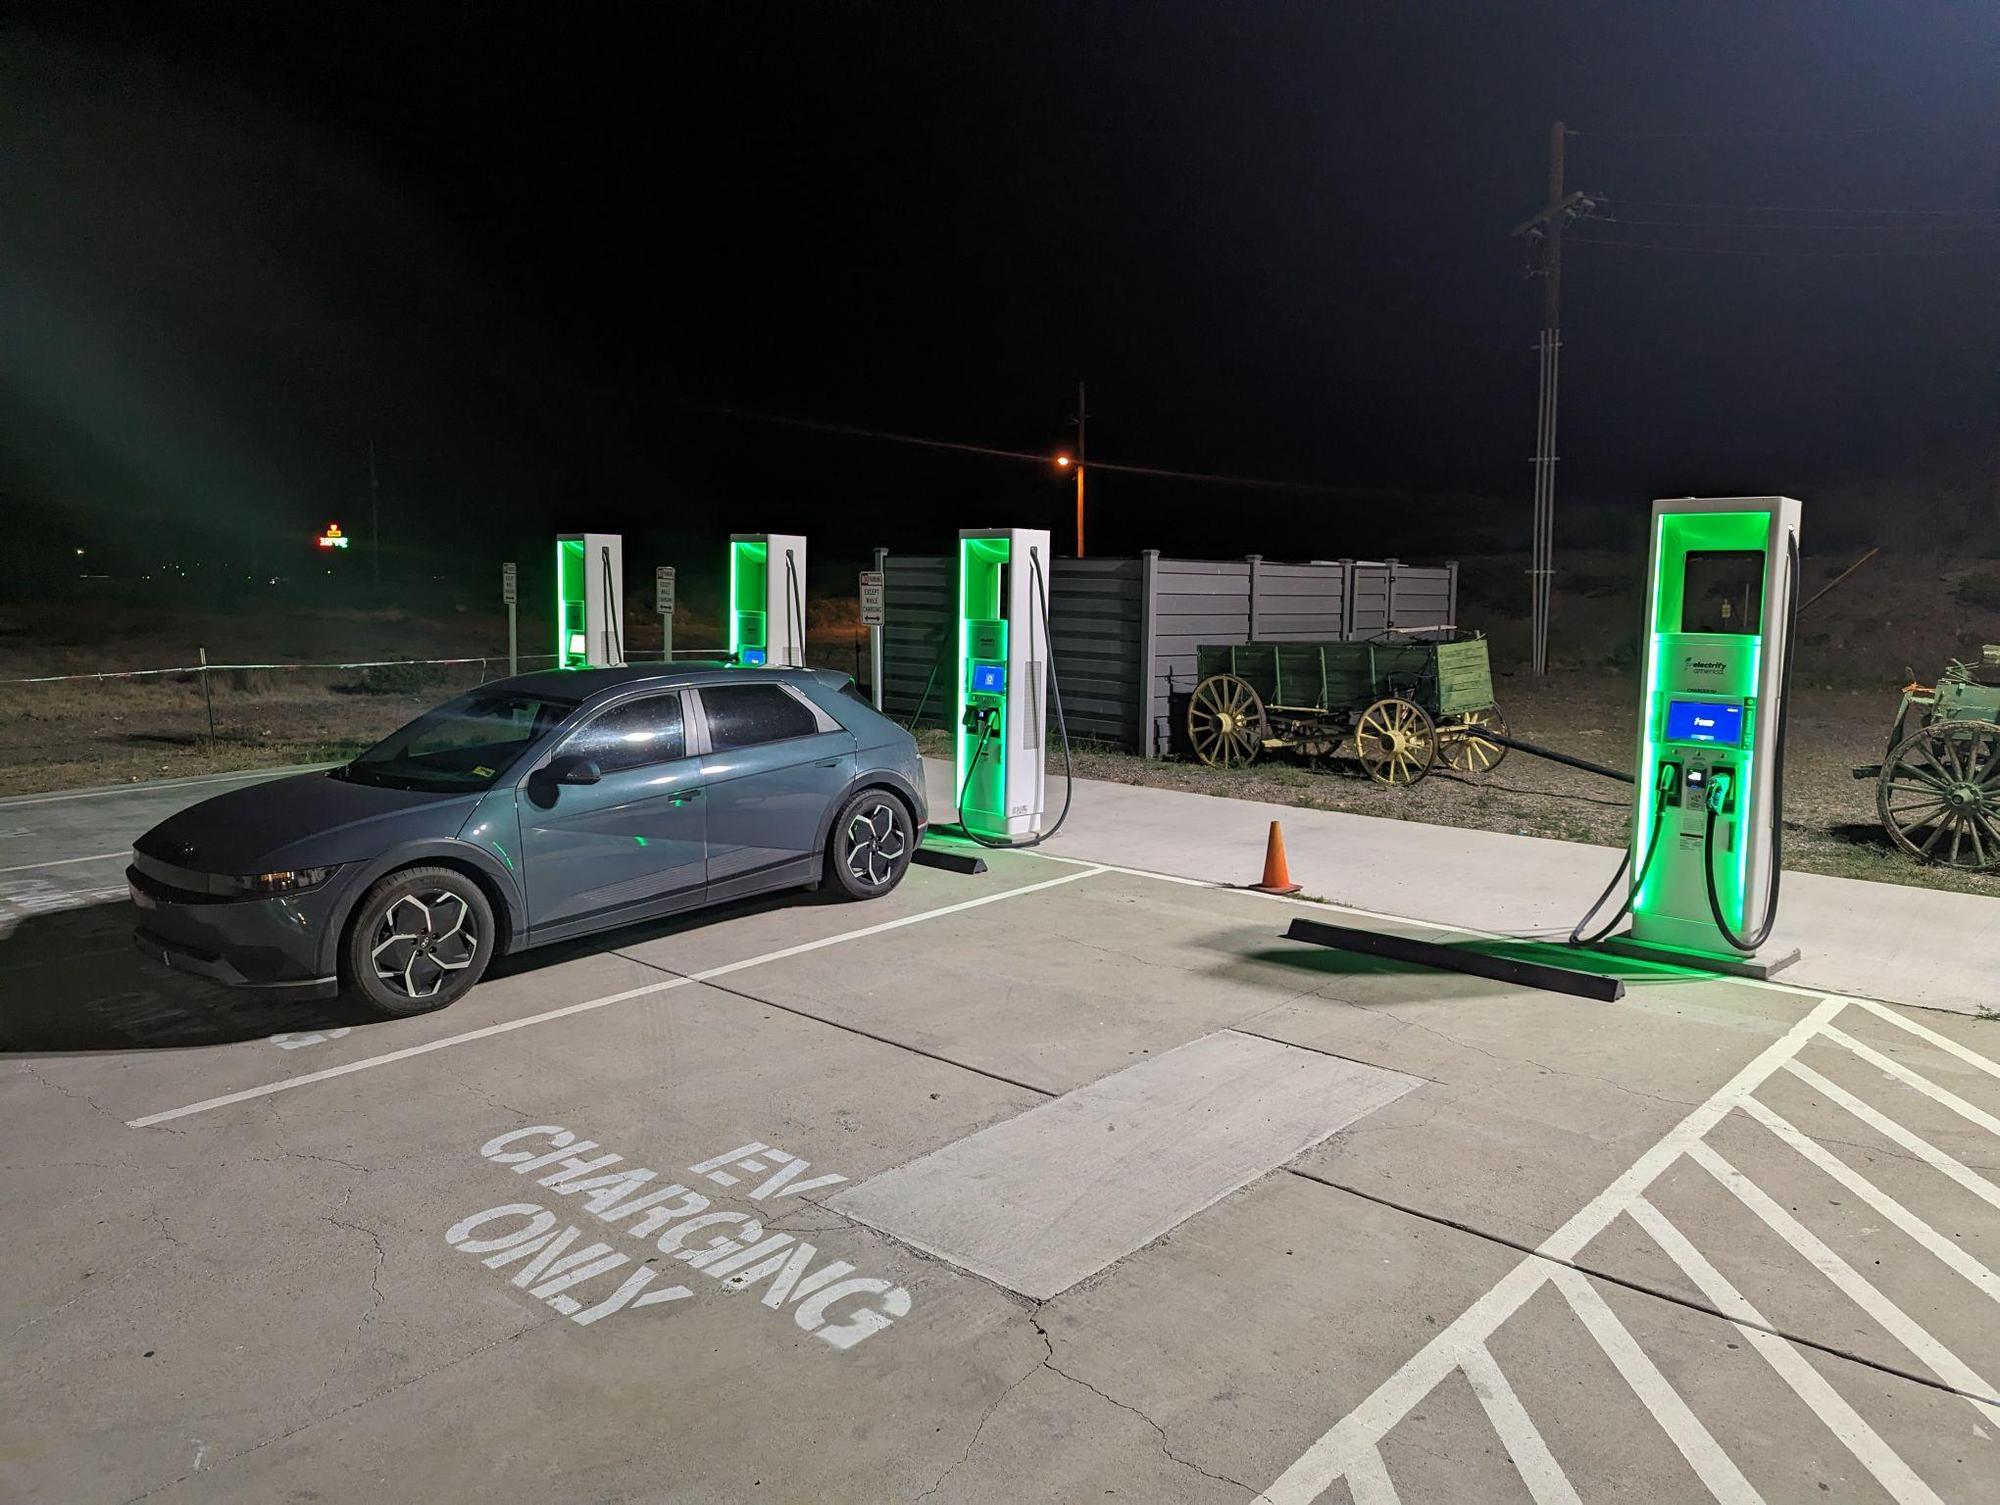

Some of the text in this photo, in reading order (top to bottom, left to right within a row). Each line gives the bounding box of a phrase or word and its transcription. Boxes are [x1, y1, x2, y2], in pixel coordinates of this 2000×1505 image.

[1692, 661, 1727, 670] electrify
[689, 1141, 849, 1200] EV
[445, 1202, 695, 1326] ONLY
[480, 1124, 912, 1350] CHARGING
